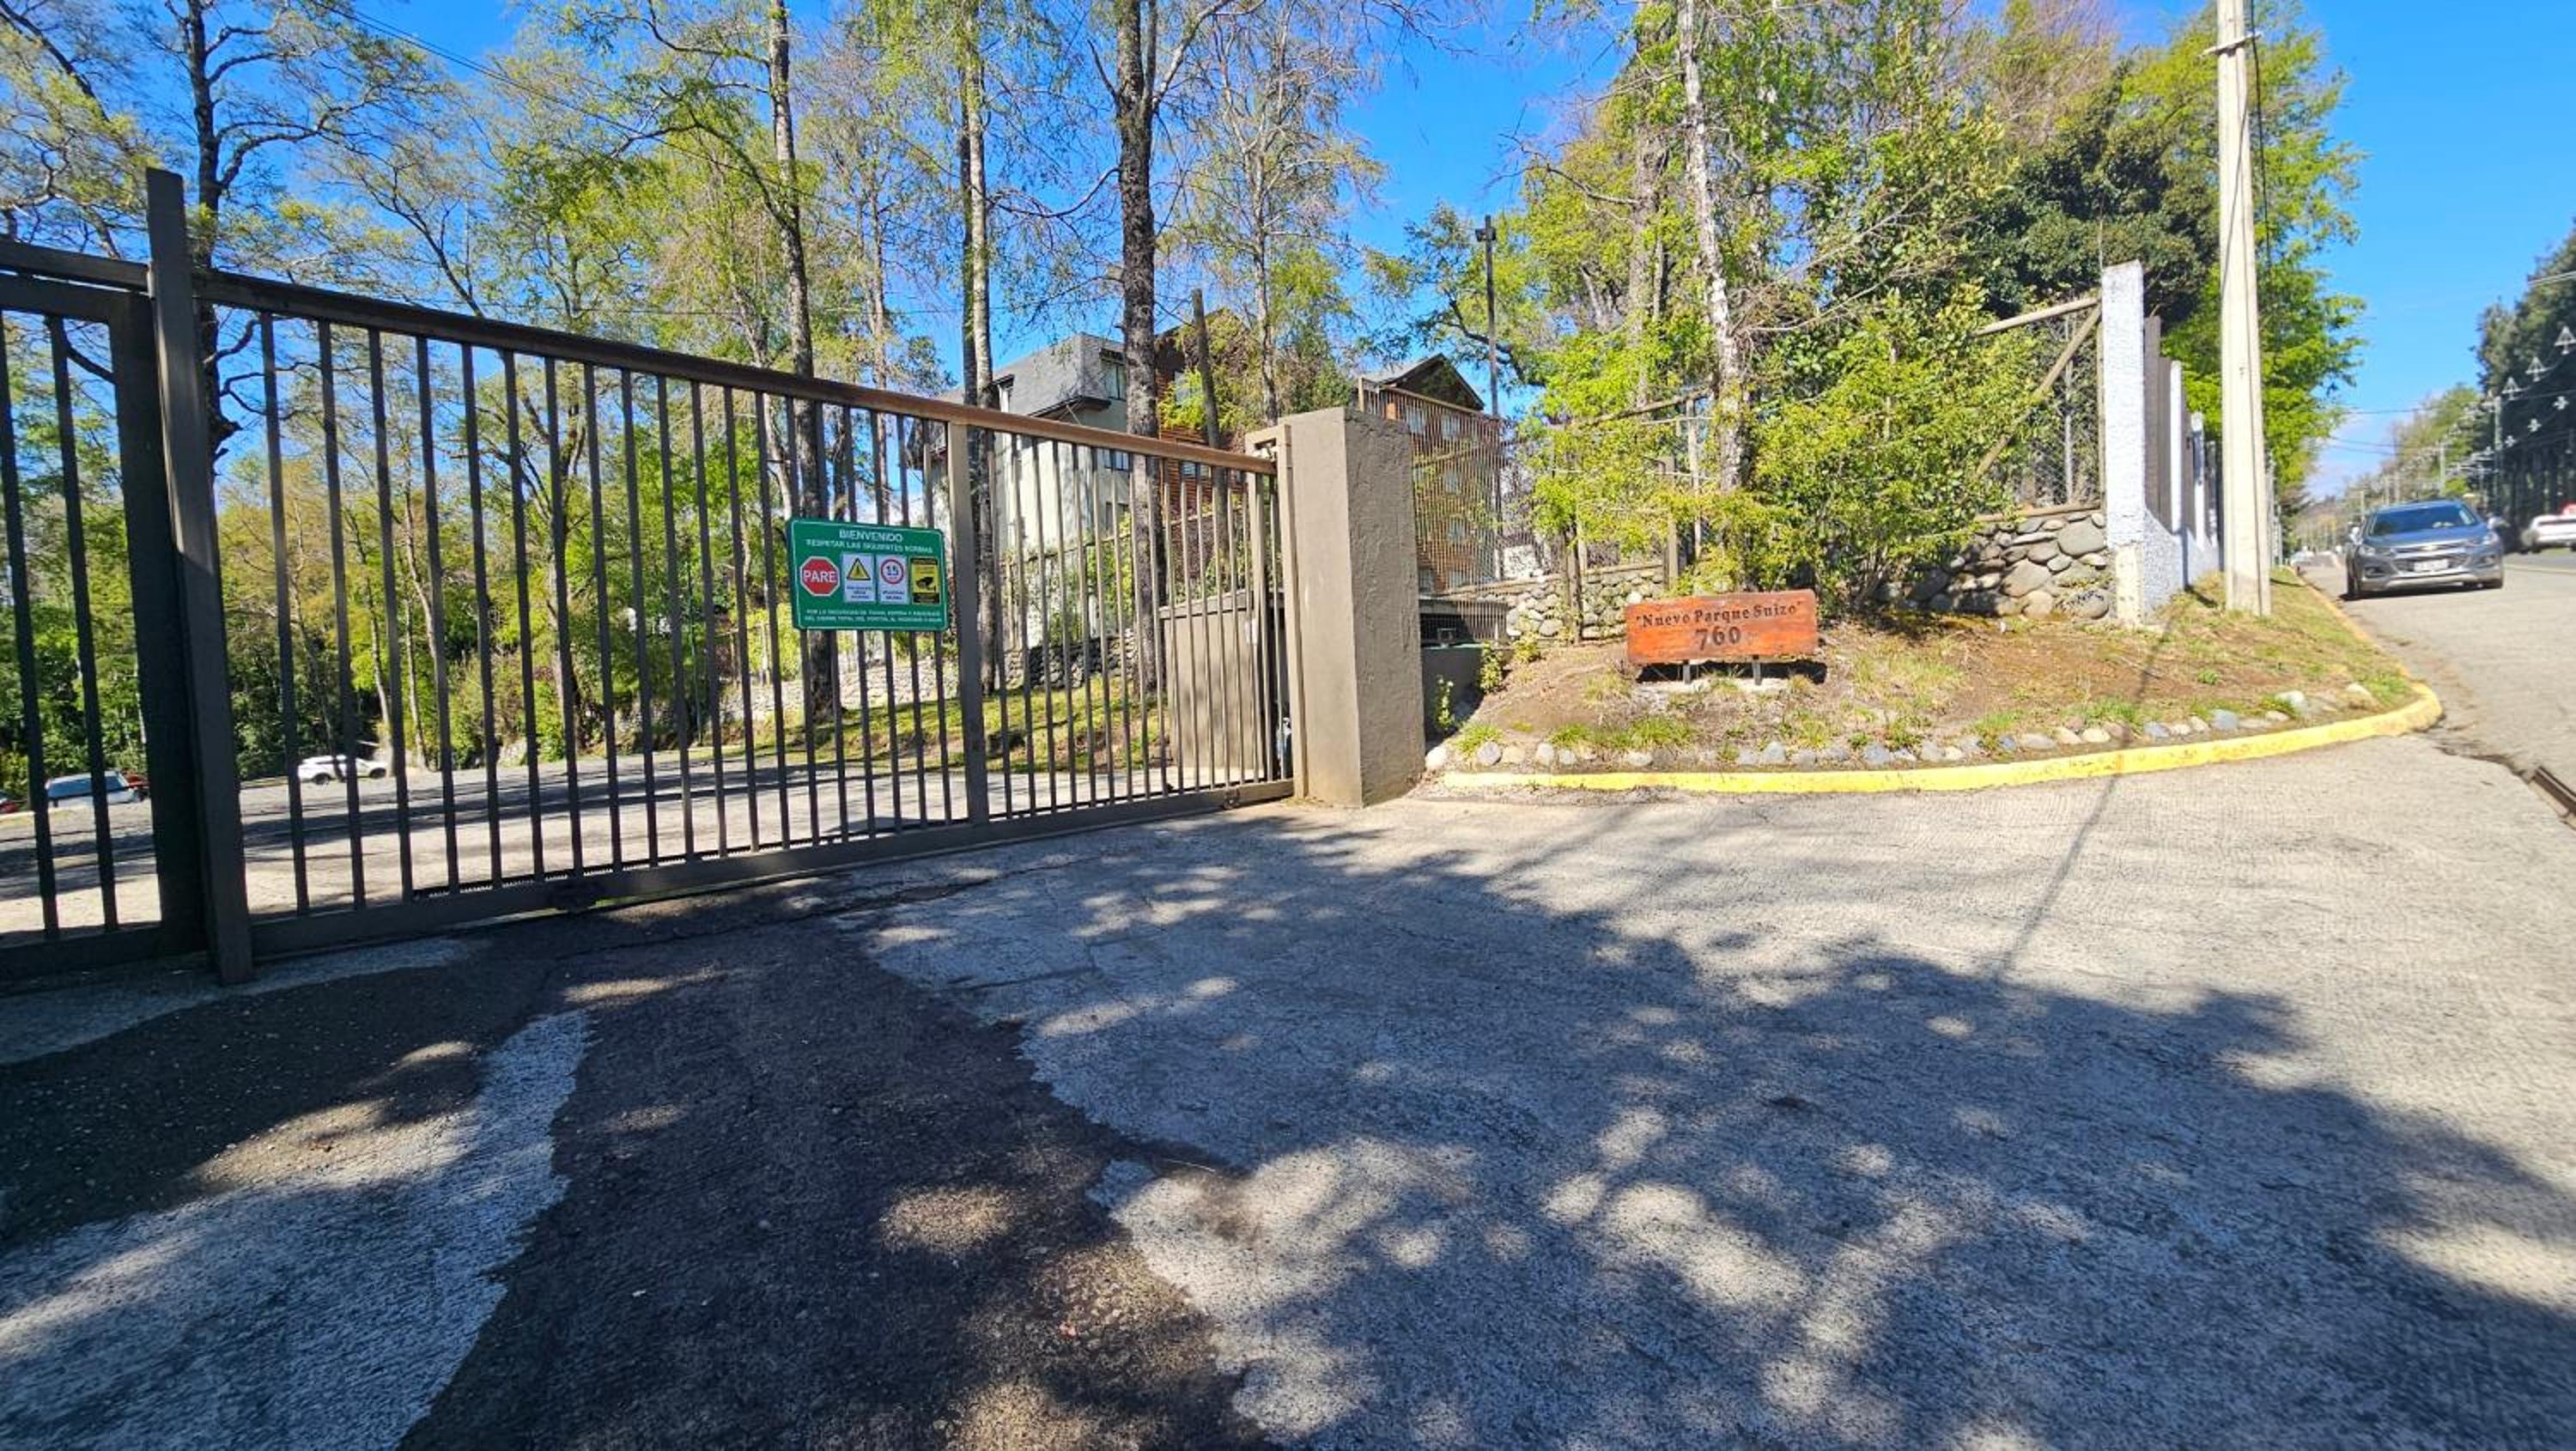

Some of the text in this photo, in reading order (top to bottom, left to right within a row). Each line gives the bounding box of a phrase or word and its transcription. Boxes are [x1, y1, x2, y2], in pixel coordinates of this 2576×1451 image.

[839, 529, 903, 543] BIENVENIDO
[803, 569, 837, 584] PARE
[1694, 608, 1750, 625] Parque
[1695, 626, 1741, 651] 760
